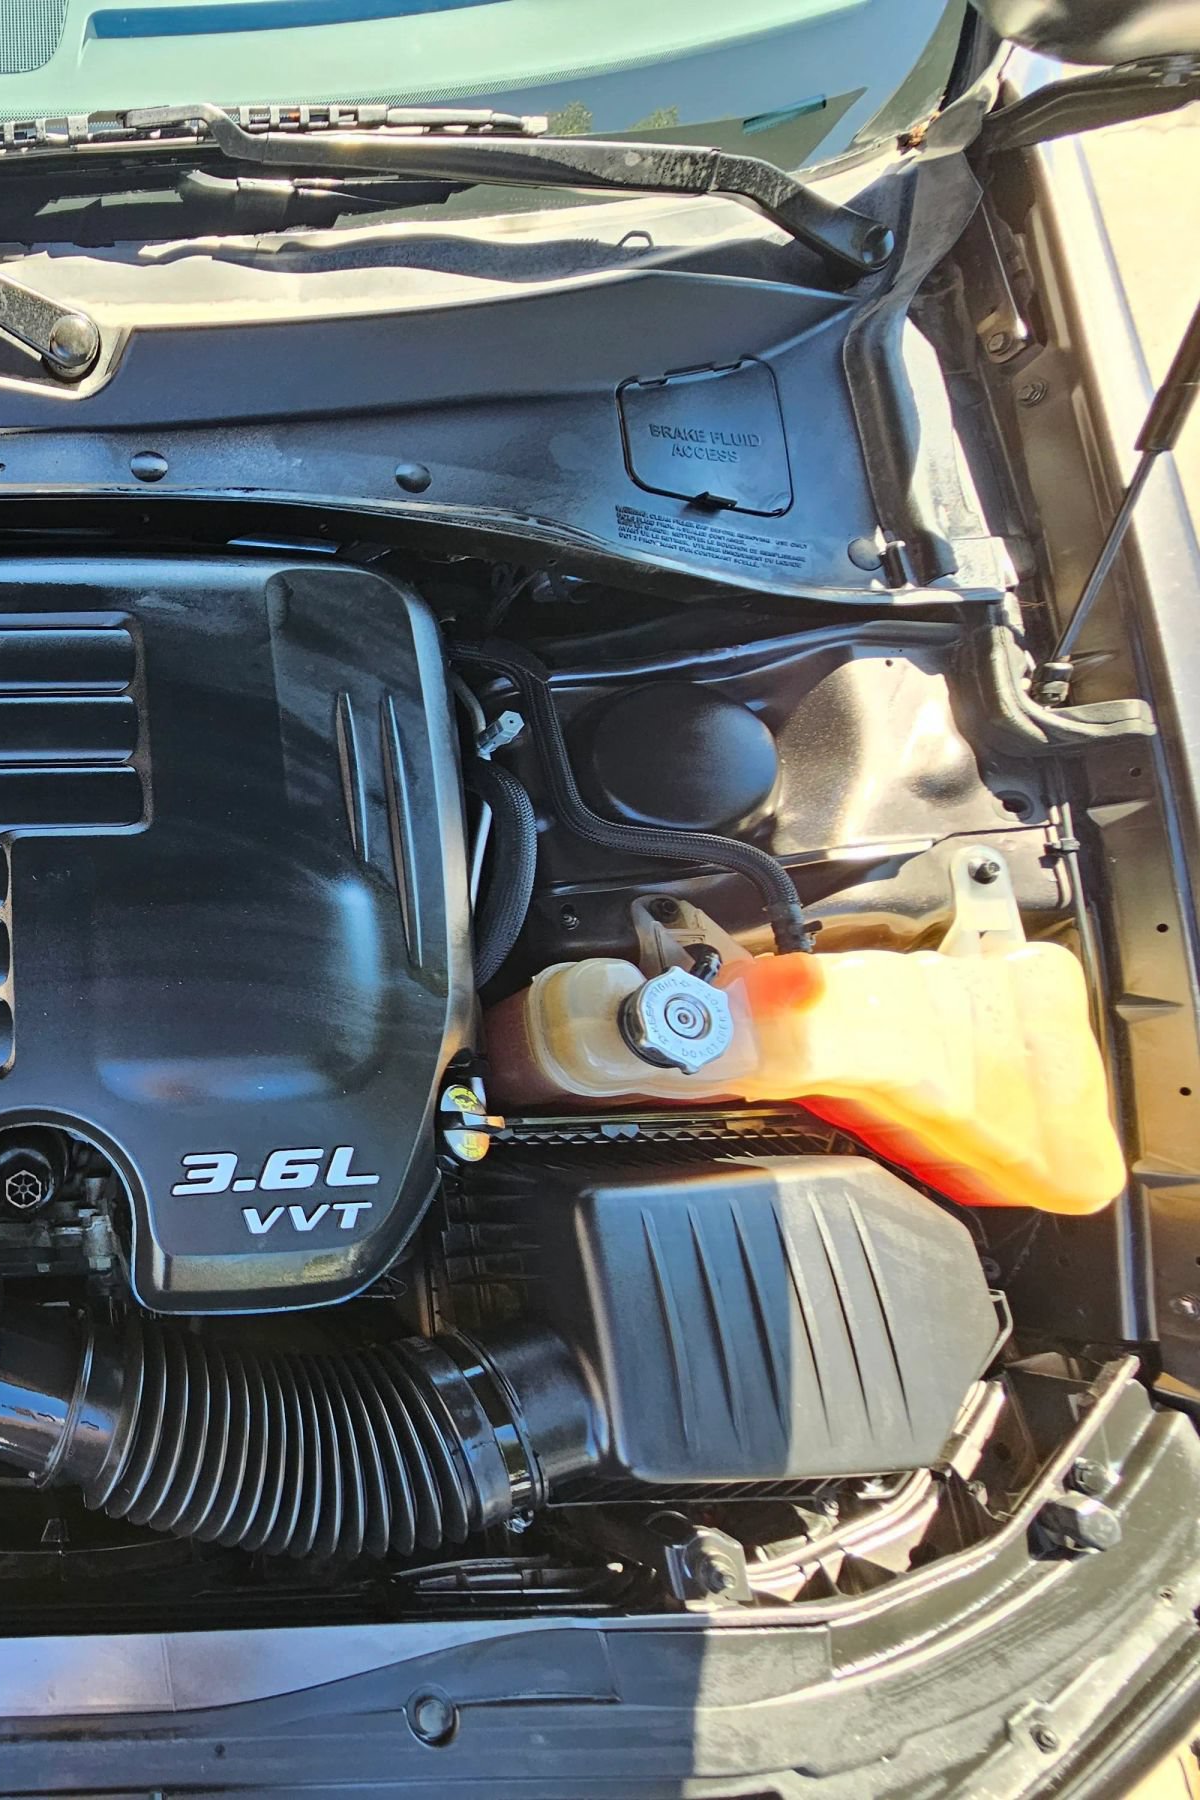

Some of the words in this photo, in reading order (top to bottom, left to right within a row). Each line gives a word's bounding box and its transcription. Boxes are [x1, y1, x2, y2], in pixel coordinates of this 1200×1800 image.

[649, 423, 707, 443] BRAKE
[710, 431, 760, 448] FLUID
[672, 443, 738, 463] ACCESS
[171, 1145, 381, 1197] 3.6L
[242, 1201, 373, 1235] VVT
